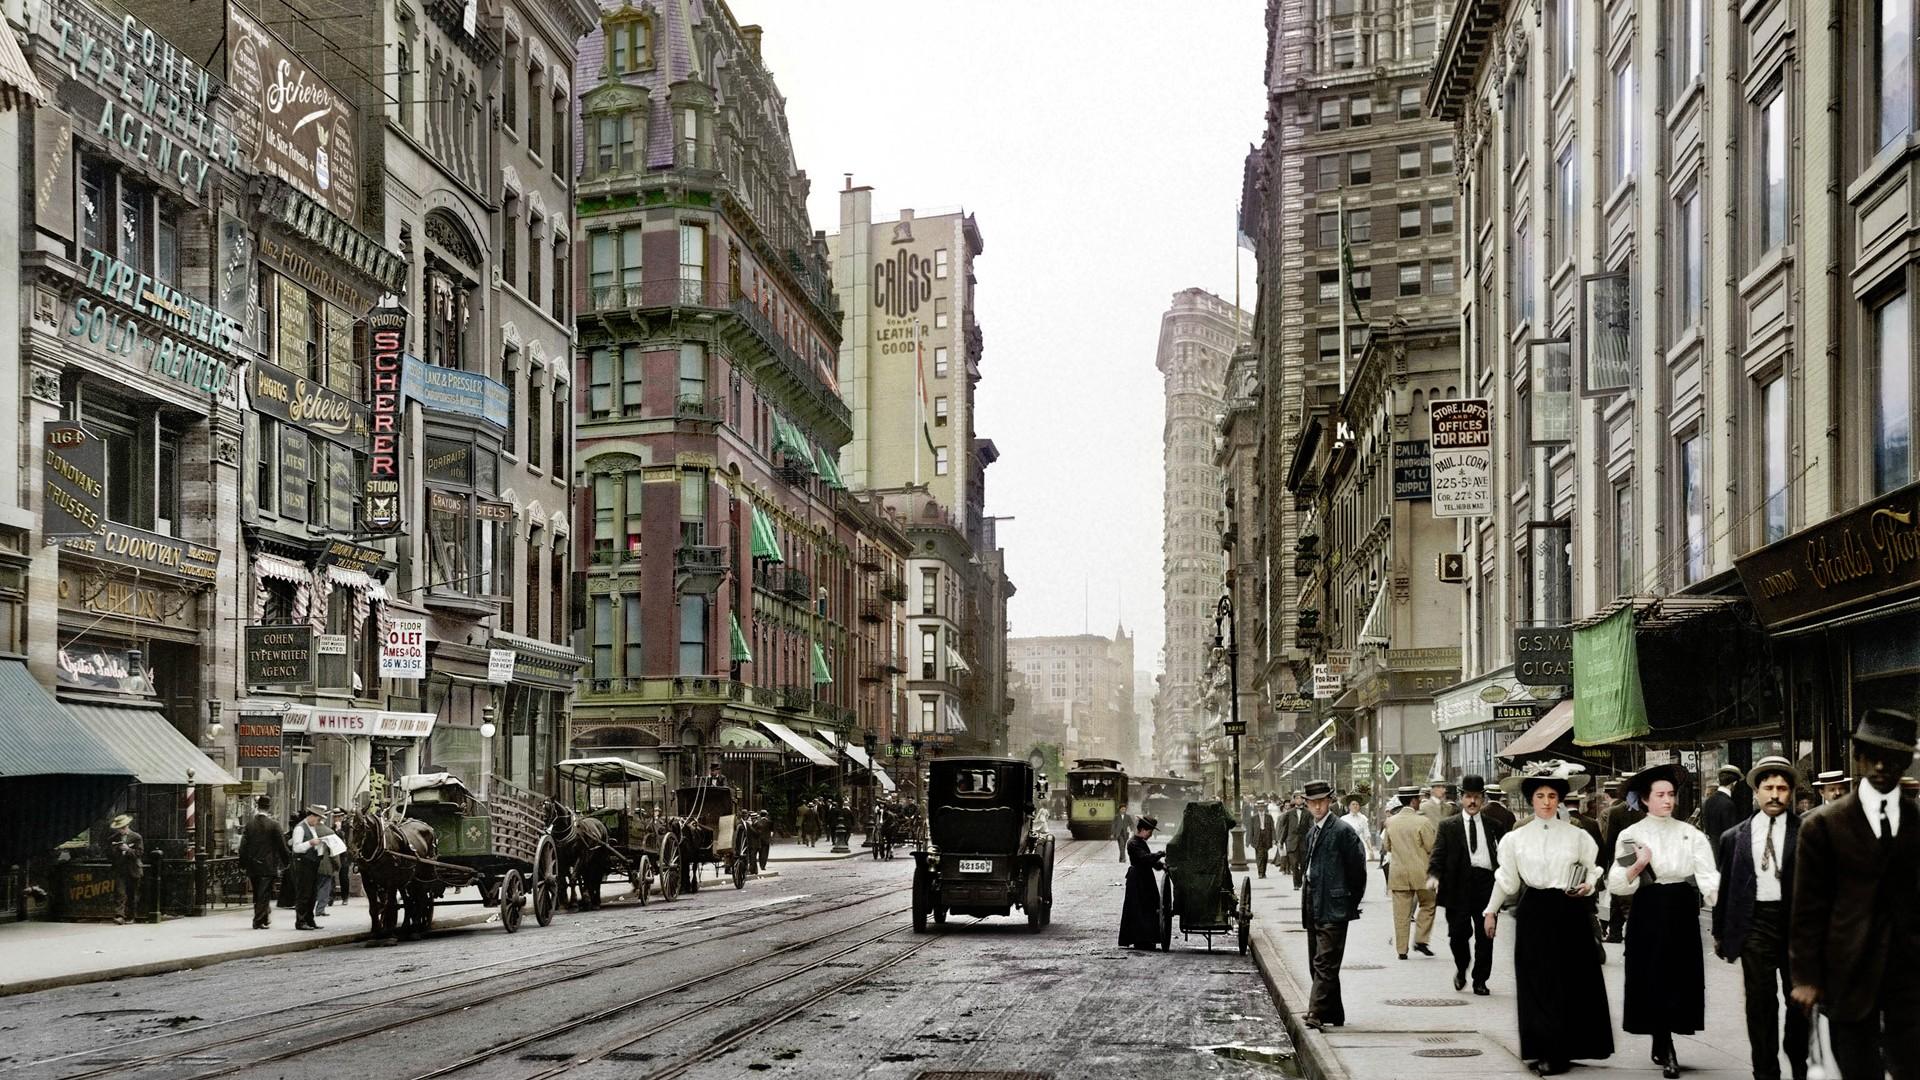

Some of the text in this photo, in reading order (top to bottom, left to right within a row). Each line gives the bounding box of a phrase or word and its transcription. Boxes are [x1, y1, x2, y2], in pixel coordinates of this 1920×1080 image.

[122, 14, 210, 105] COHEN
[267, 58, 332, 114] Scherer
[57, 17, 241, 174] TYPEWRITER
[97, 100, 210, 195] AGENCY
[280, 245, 358, 311] FOTOGRAFER
[874, 248, 931, 319] CROSS
[86, 249, 237, 352] TYPEWRITERS
[371, 314, 405, 328] PHOTOS
[69, 298, 227, 394] SOLD RENTED
[289, 378, 352, 422] Scherer
[372, 332, 400, 475] SCHERER
[1438, 420, 1482, 432] OFFICES
[50, 431, 84, 444] 1164
[1433, 431, 1488, 445] FOR RENT
[1395, 444, 1420, 457] EMIL
[428, 448, 467, 475] PORTRAITS
[1435, 456, 1456, 473] PAUL
[1465, 454, 1489, 472] CORN
[46, 449, 102, 498] DONOVAN'S
[366, 480, 398, 493] STUDIO
[1395, 481, 1429, 493] SUPPLY
[46, 480, 100, 530] TRUSSES
[432, 493, 461, 511] CRAYONS
[476, 504, 506, 518] STELS
[336, 557, 366, 571] TAILORS
[1805, 528, 1873, 590] Charles
[401, 622, 422, 630] FLOOR
[263, 633, 295, 645] COHEN
[402, 632, 422, 645] LET
[251, 648, 308, 662] TYPEWRITER
[383, 659, 393, 668] 26
[261, 665, 298, 677] AGENCY
[1497, 707, 1532, 718] KODAKS
[318, 714, 365, 729] WHITE'S
[239, 723, 281, 737] DONOVAN'S
[239, 745, 281, 758] TRUSSES
[959, 862, 985, 870] 42156
